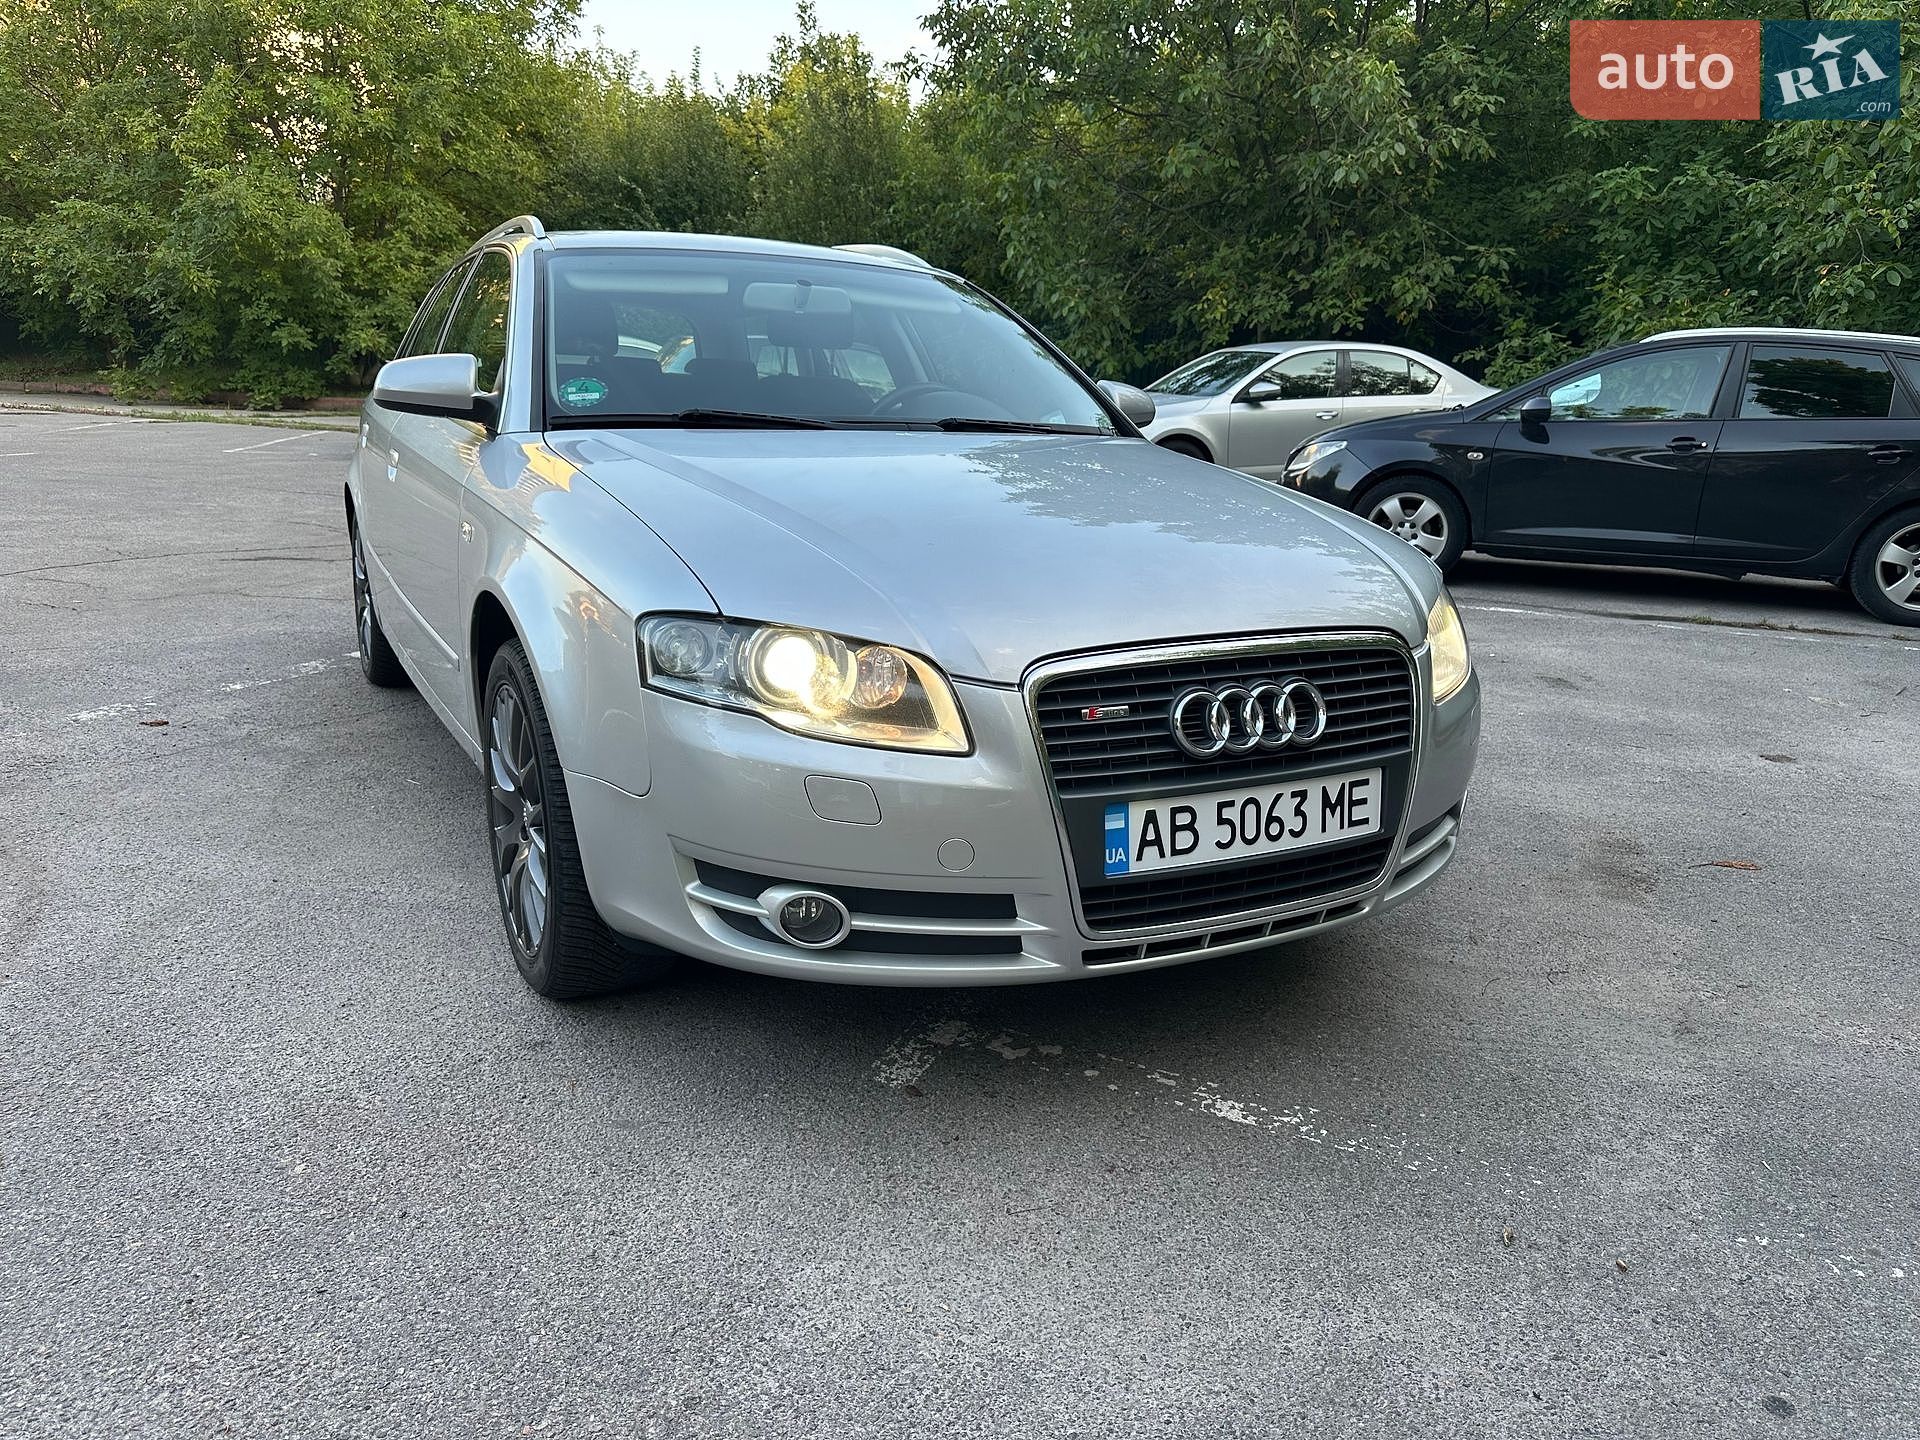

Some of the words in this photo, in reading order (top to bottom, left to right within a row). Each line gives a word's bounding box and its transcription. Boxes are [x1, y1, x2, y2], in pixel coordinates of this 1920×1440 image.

[1135, 804, 1200, 862] AB
[1214, 788, 1309, 850] 5063
[1320, 777, 1370, 833] ME
[1105, 847, 1127, 864] UA
